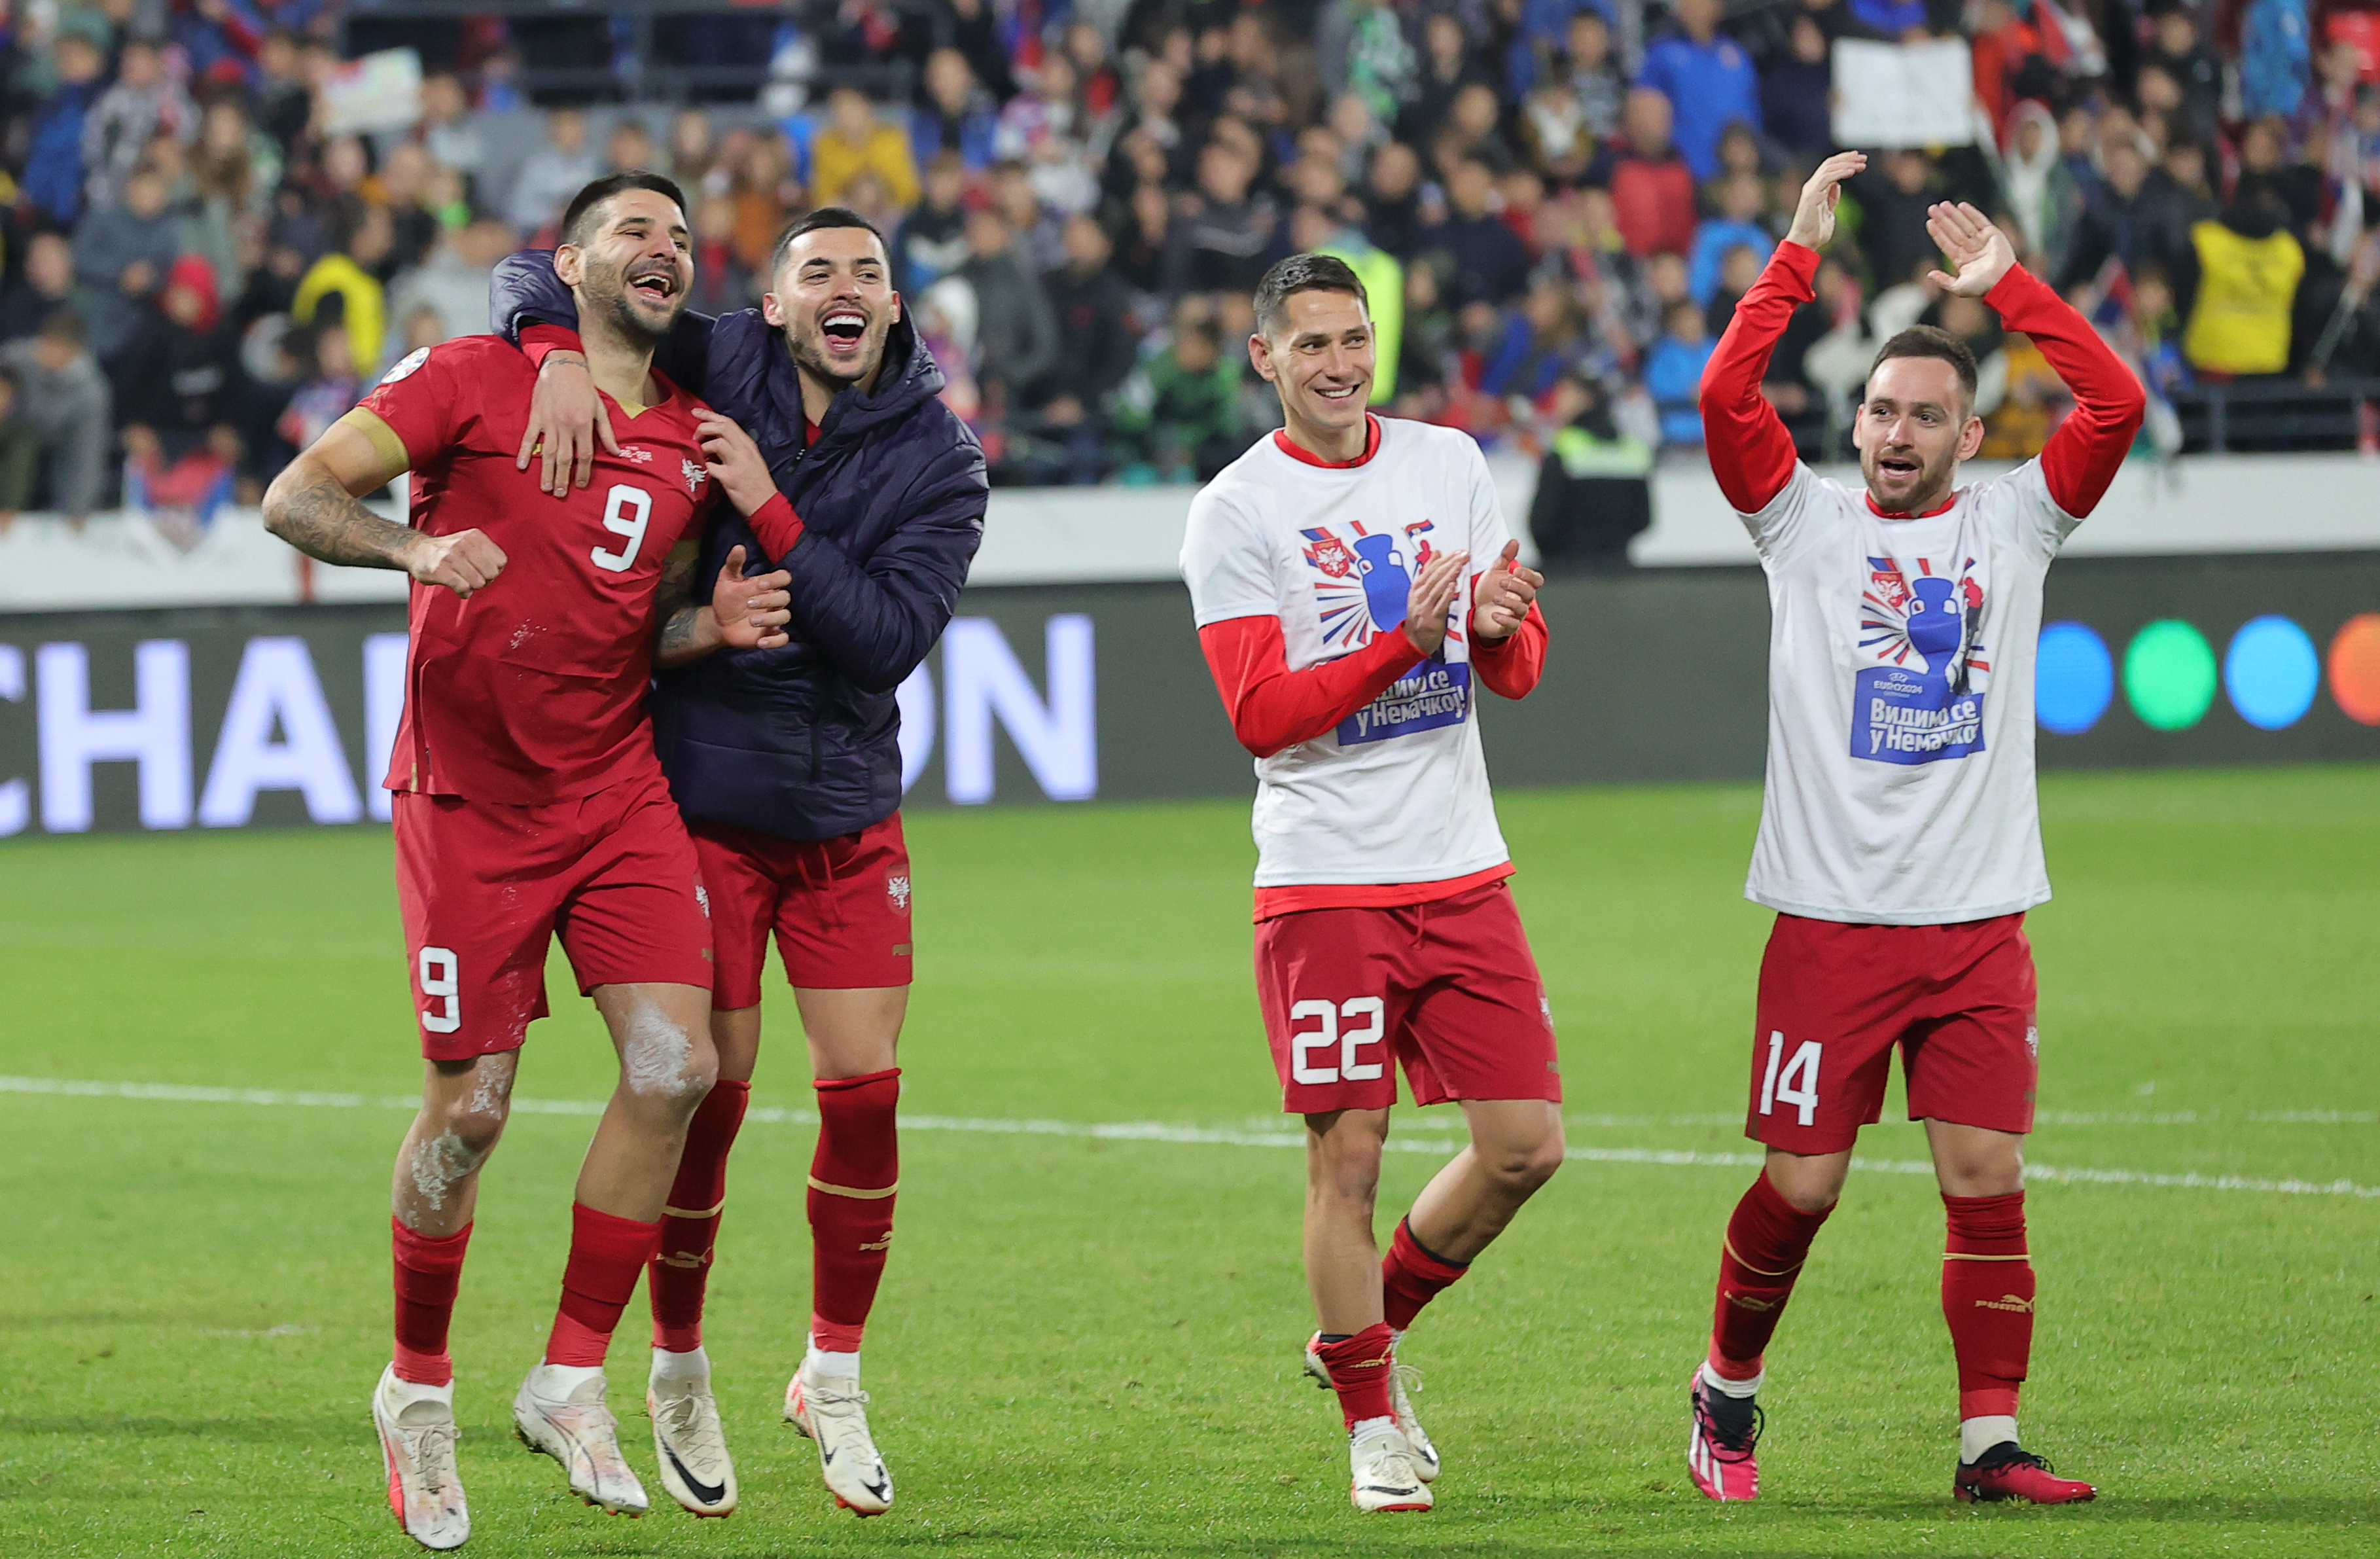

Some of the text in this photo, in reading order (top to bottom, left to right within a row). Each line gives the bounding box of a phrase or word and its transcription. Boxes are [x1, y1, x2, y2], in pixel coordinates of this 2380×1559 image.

[590, 484, 653, 573] 9
[1428, 670, 1451, 690] се
[1355, 711, 1369, 738] у
[1869, 728, 1885, 755] у
[1870, 696, 1977, 728] Видимо се
[419, 946, 461, 1034] 9
[1290, 995, 1385, 1085] 22
[1759, 1030, 1823, 1126] 14
